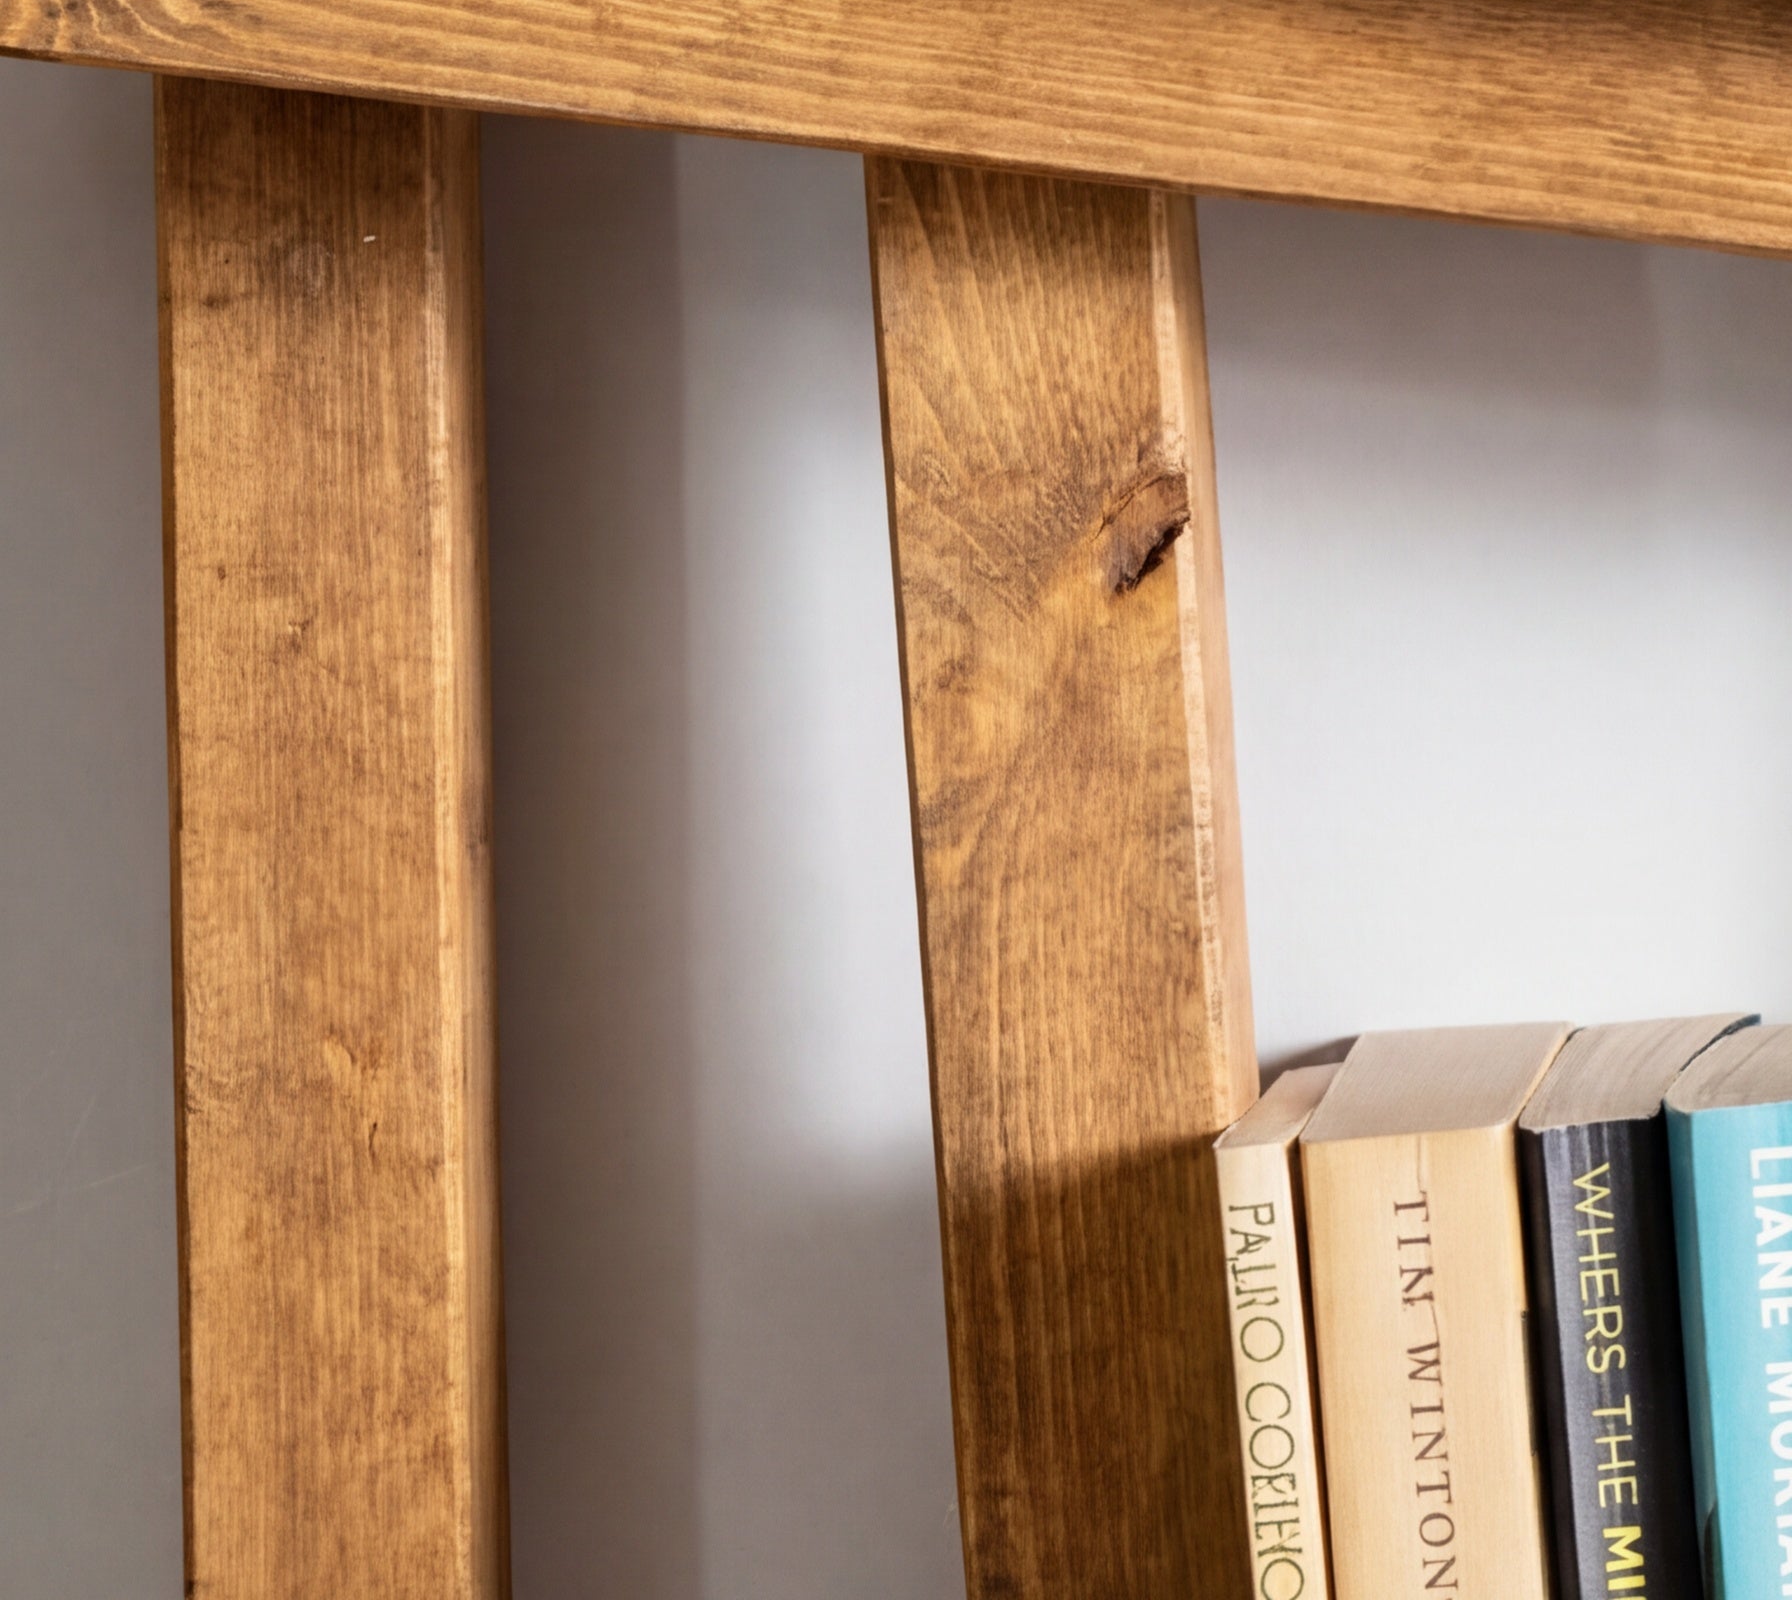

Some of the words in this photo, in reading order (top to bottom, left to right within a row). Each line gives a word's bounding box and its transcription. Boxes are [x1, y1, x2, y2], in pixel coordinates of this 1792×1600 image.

[1407, 1338, 1460, 1600] WINTON
[1592, 1394, 1639, 1509] THE
[1602, 1524, 1648, 1600] MI
